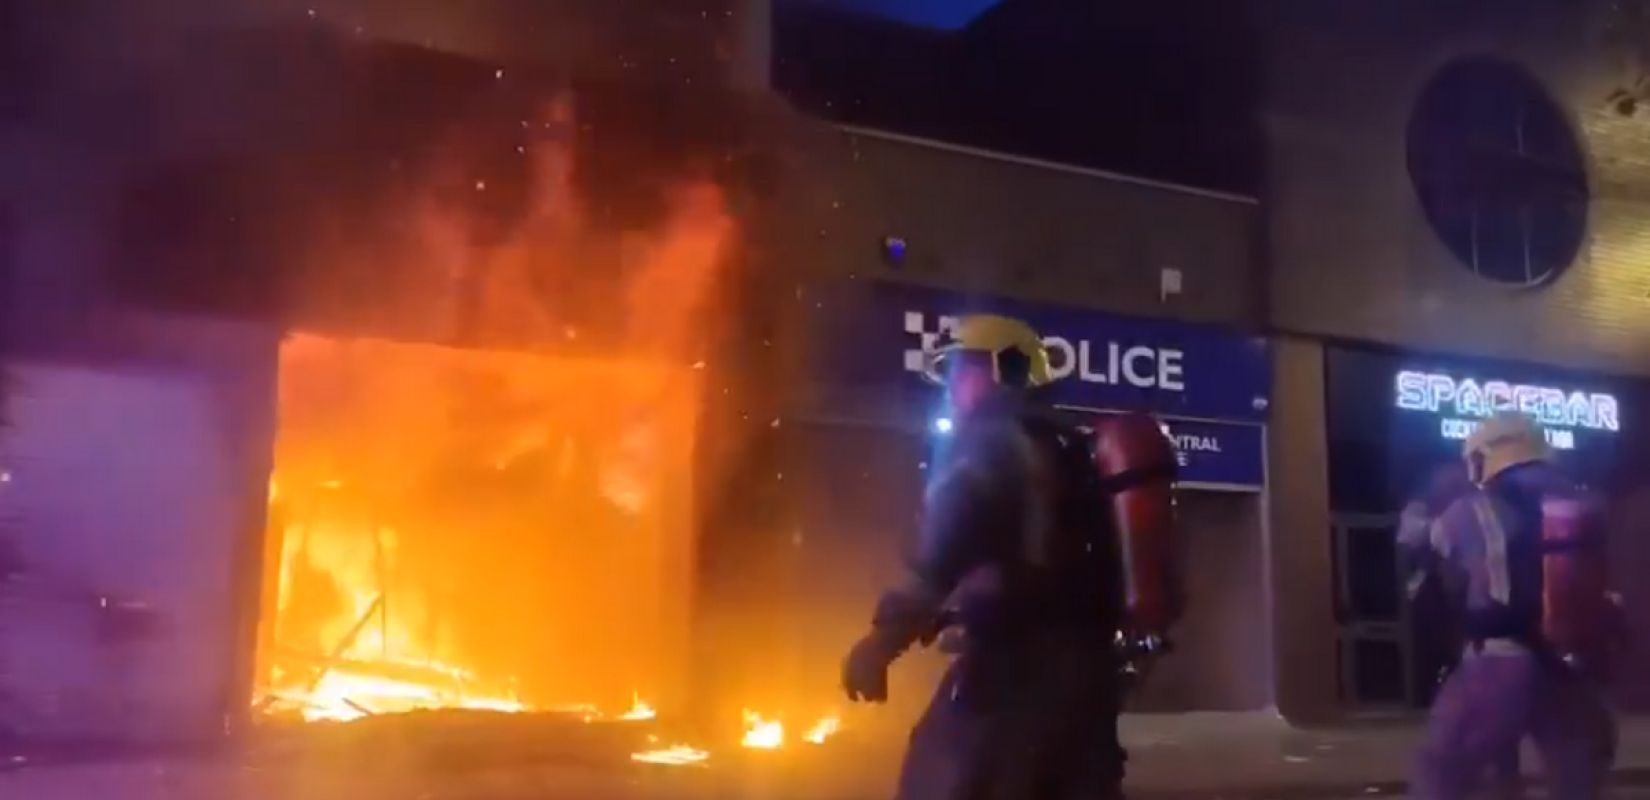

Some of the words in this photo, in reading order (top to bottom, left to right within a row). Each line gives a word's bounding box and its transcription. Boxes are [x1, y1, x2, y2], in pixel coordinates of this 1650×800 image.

[1038, 336, 1185, 391] OLICE
[1395, 370, 1619, 431] SPACEBAR
[1168, 434, 1222, 452] NTRAL
